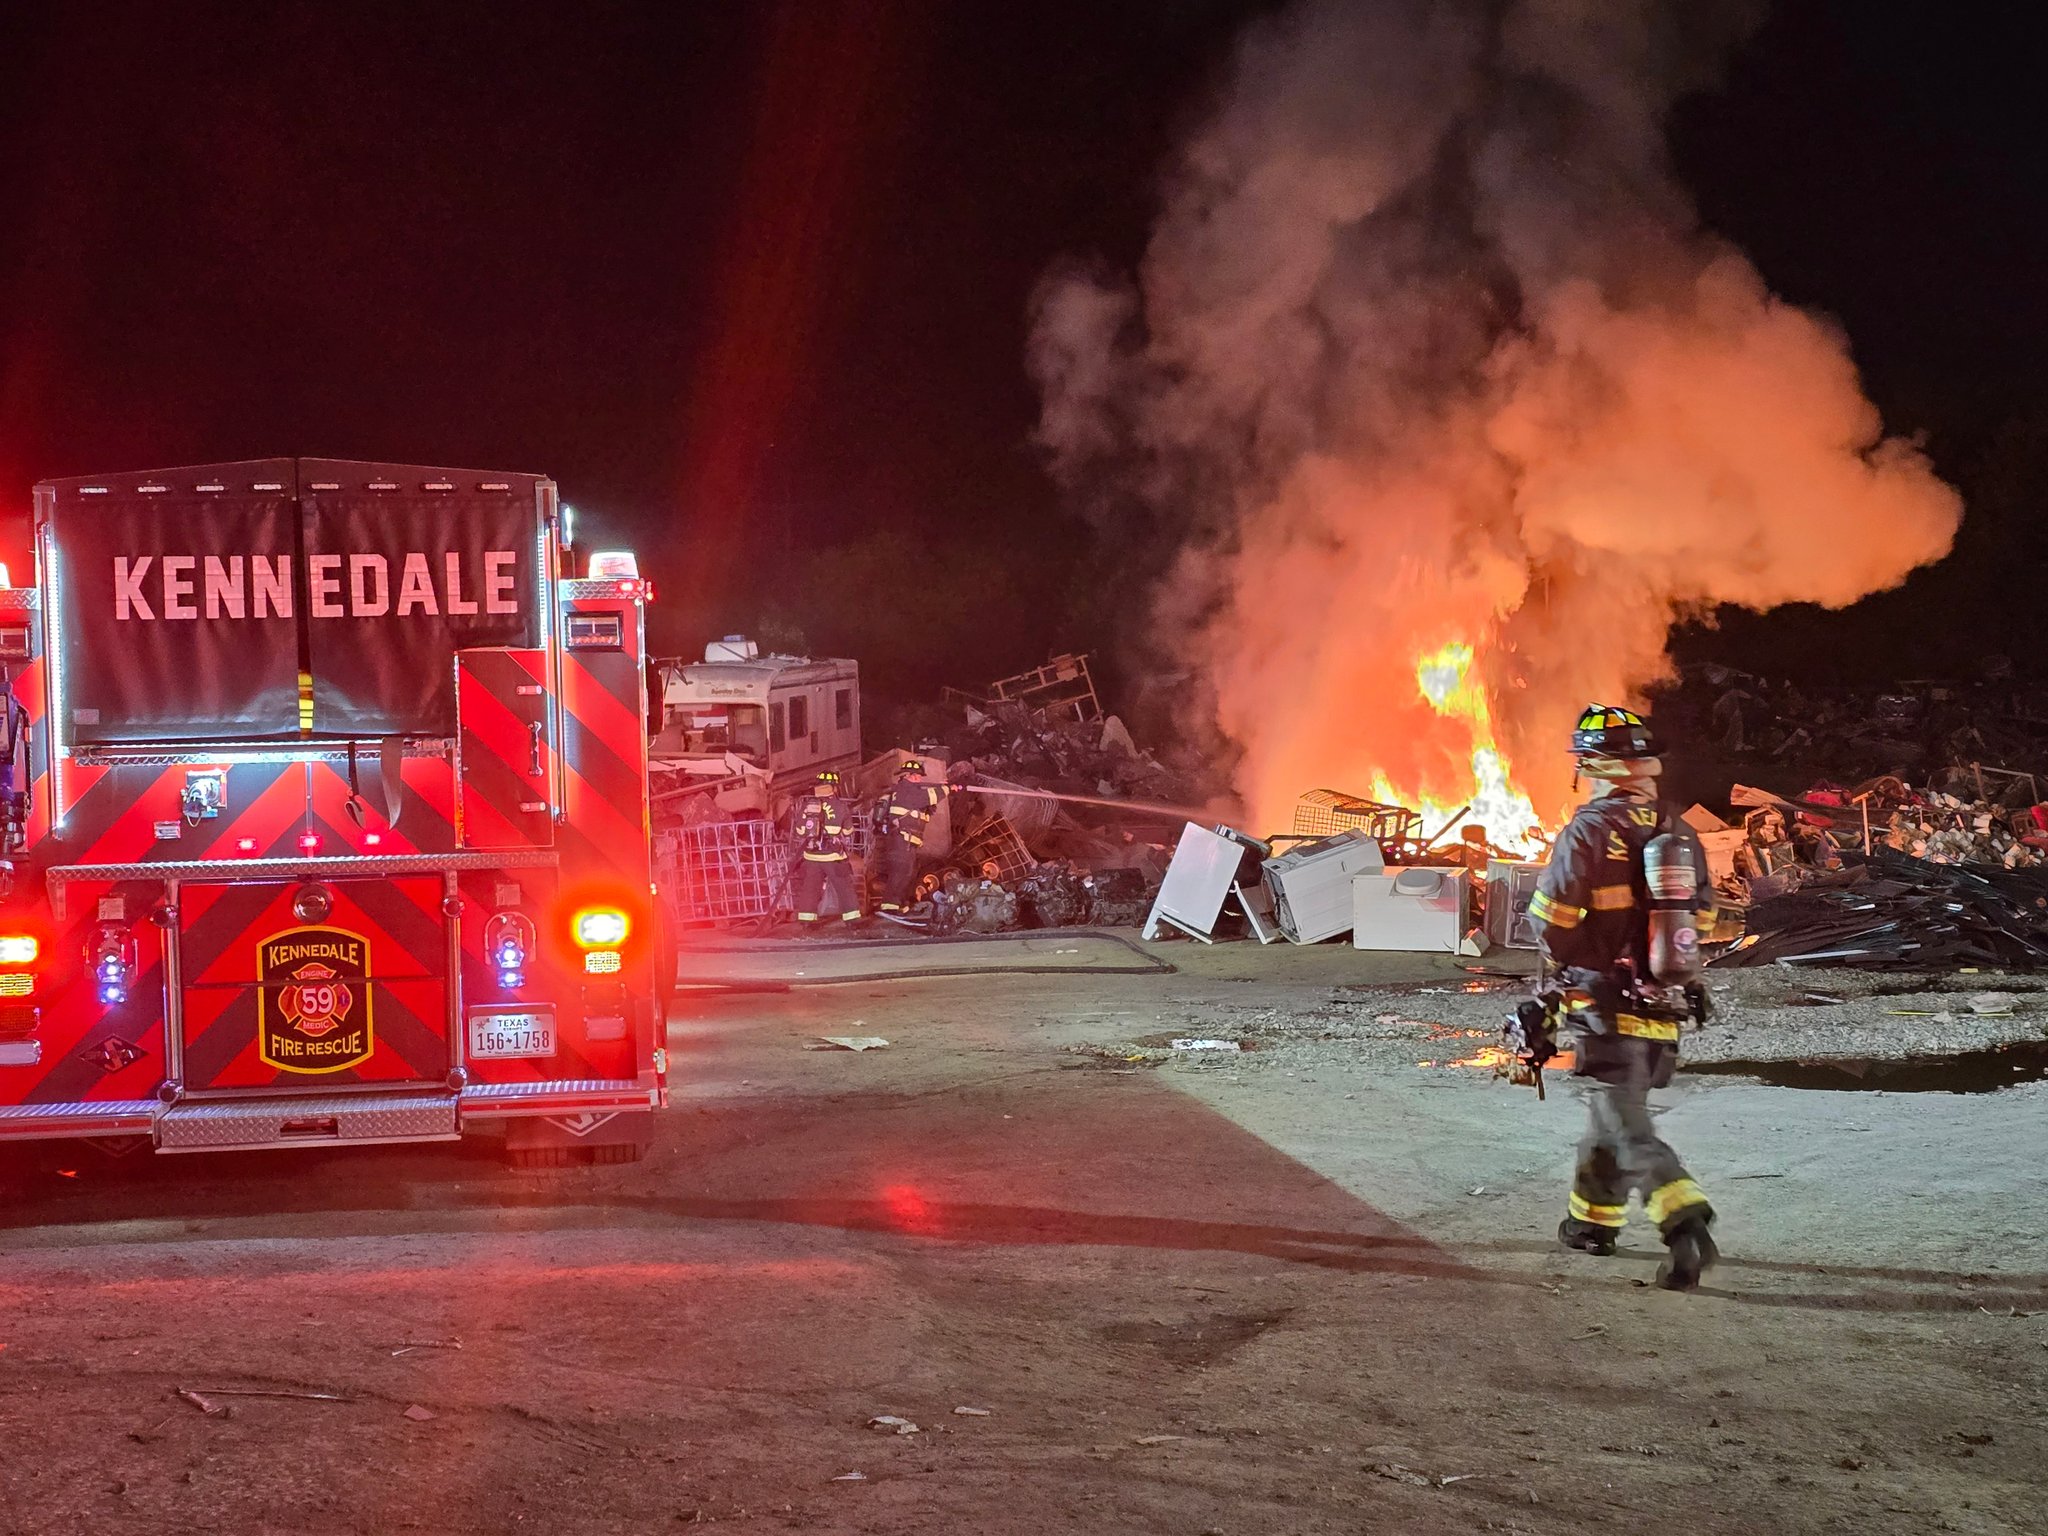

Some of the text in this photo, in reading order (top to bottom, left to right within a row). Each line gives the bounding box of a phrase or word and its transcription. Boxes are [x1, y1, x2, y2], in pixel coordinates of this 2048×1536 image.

[114, 551, 518, 620] KENNEDALE
[269, 943, 359, 969] KENNEDALE
[300, 969, 329, 979] ENGINE
[302, 987, 333, 1014] 59
[303, 1020, 330, 1030] MEDIC
[497, 1018, 529, 1027] TEXAS
[272, 1030, 361, 1056] FIRE RESCUE
